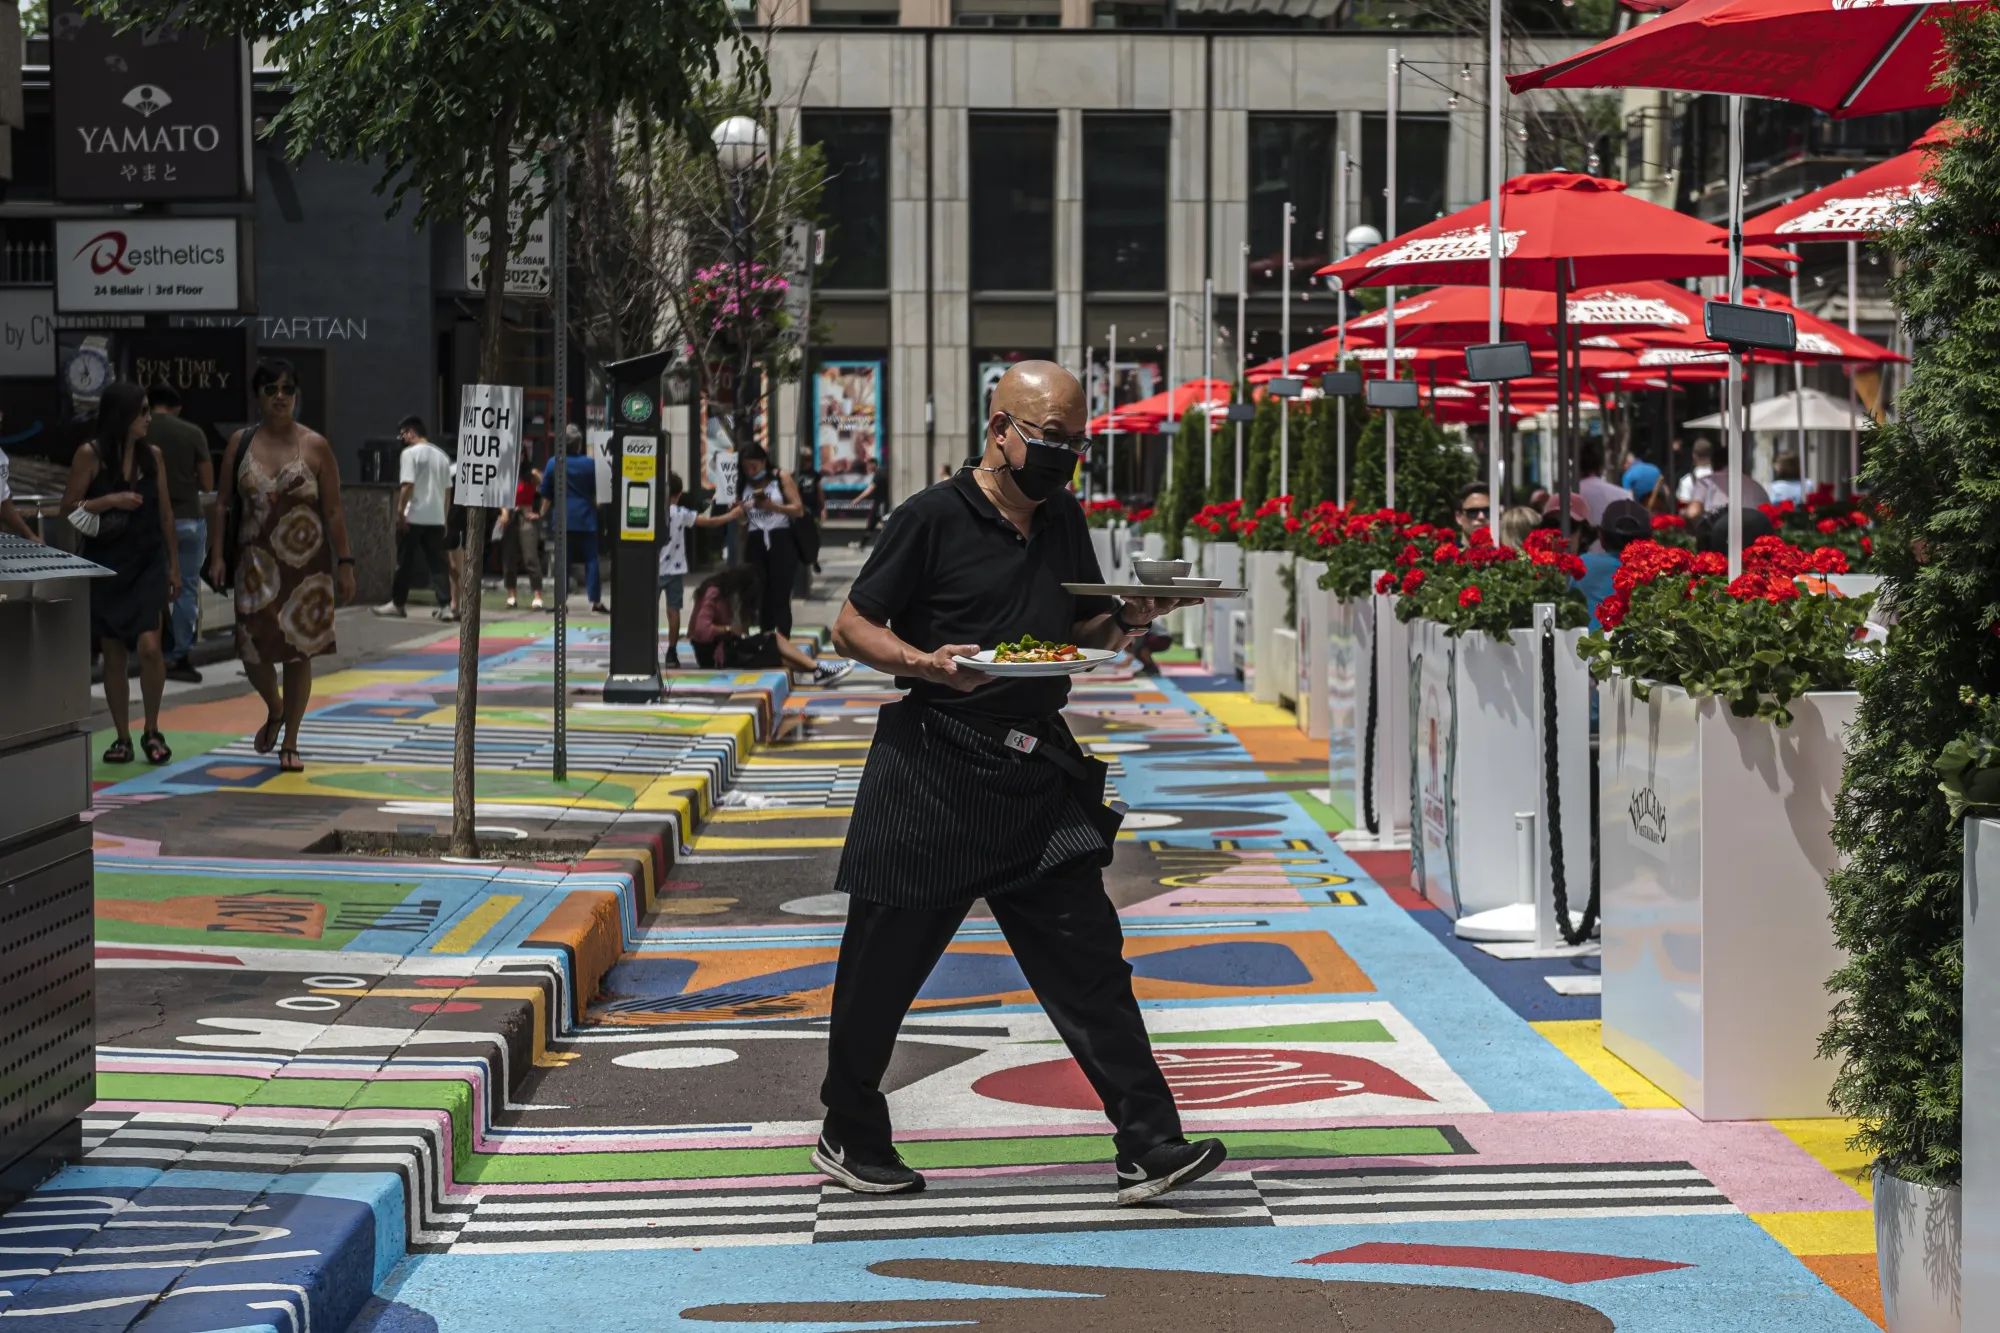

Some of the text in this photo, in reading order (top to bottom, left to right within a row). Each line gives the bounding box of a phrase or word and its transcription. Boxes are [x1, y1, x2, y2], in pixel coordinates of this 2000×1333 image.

[77, 124, 219, 153] YAMATO
[120, 164, 177, 181] やまと
[1409, 240, 1490, 252] STELL
[1396, 249, 1488, 262] ARTOIS
[94, 283, 204, 296] 24 Bellair 3rd Floor
[1583, 304, 1659, 313] STELLA
[1589, 312, 1666, 321] ARTOIS
[5, 323, 24, 350] by
[261, 318, 368, 340] TARTAN
[174, 356, 218, 374] TIME
[463, 406, 510, 430] WATCH
[463, 434, 501, 458] YOUR
[626, 444, 653, 454] 6027
[461, 462, 497, 486] STEP
[1628, 787, 1667, 844] VATICANO
